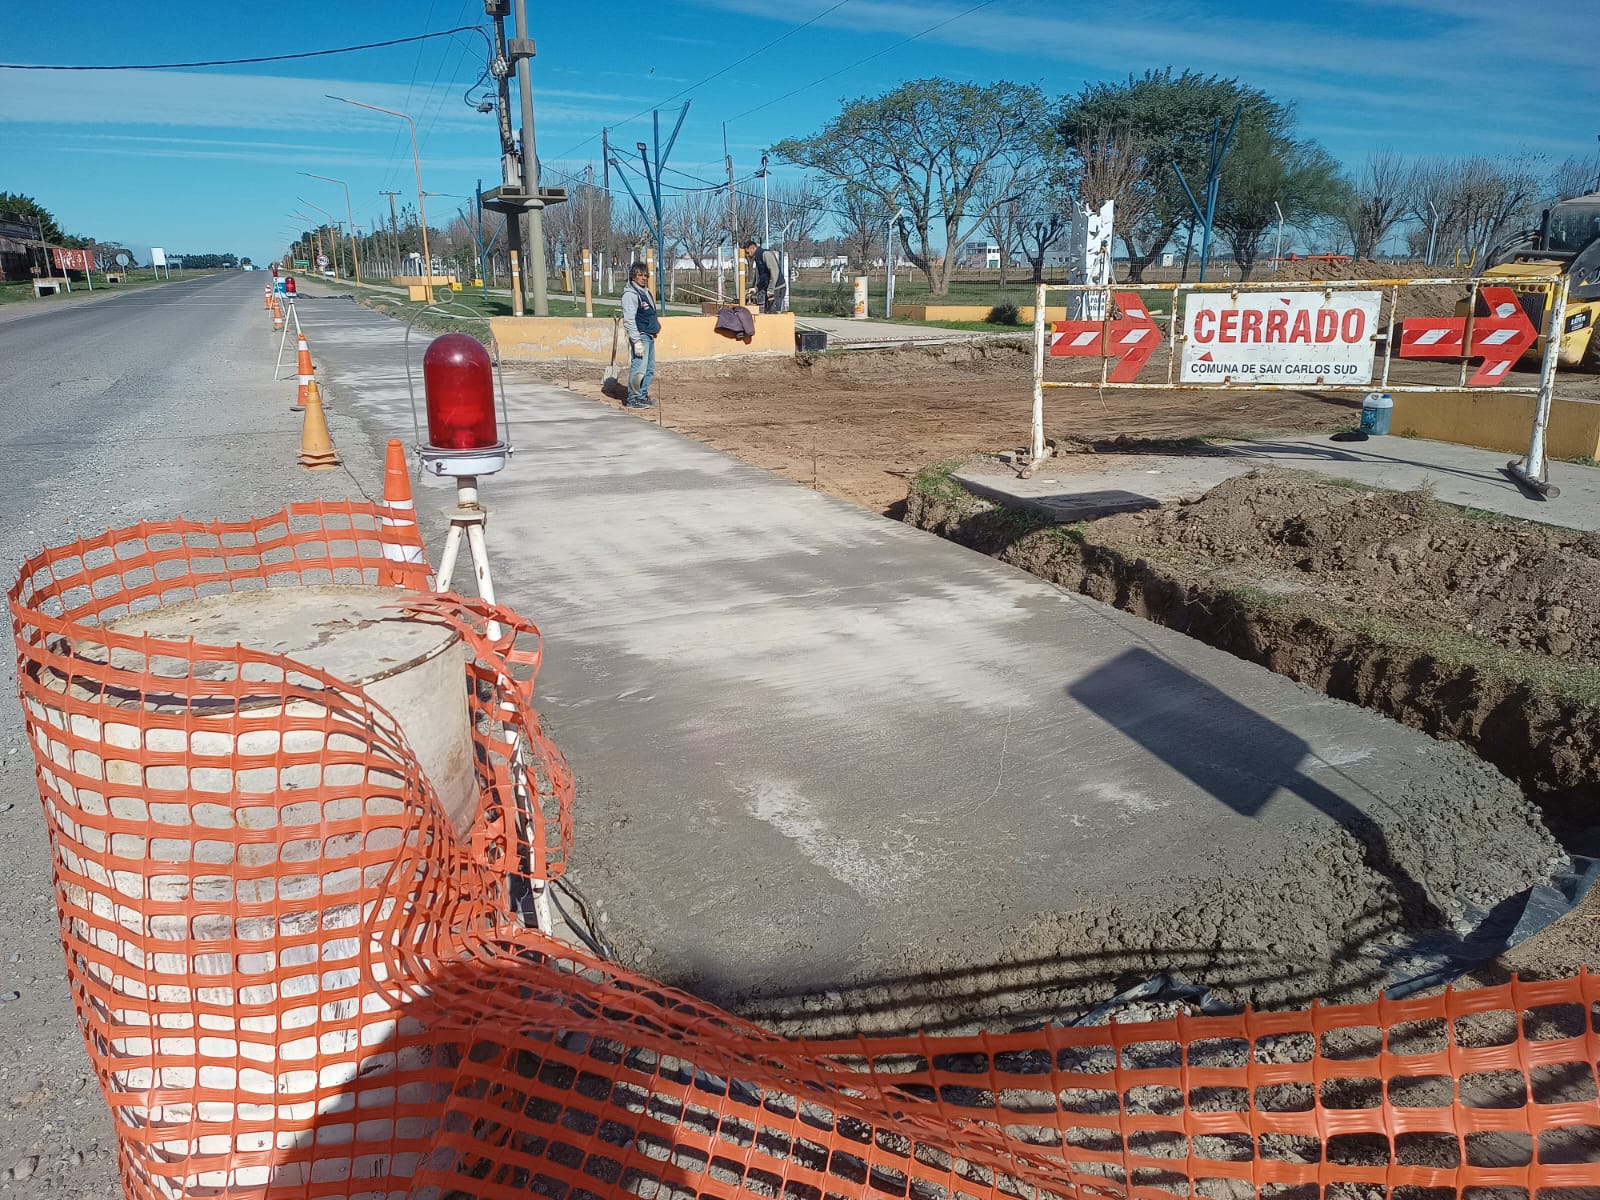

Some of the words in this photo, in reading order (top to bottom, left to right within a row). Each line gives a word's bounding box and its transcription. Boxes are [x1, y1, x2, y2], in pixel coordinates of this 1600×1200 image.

[1194, 308, 1366, 344] CERRADO
[1191, 363, 1239, 374] COMUNA
[1241, 364, 1257, 374] DE
[1259, 364, 1282, 374] SAN
[1285, 364, 1331, 375] CARLOS
[1333, 364, 1358, 375] SUD
